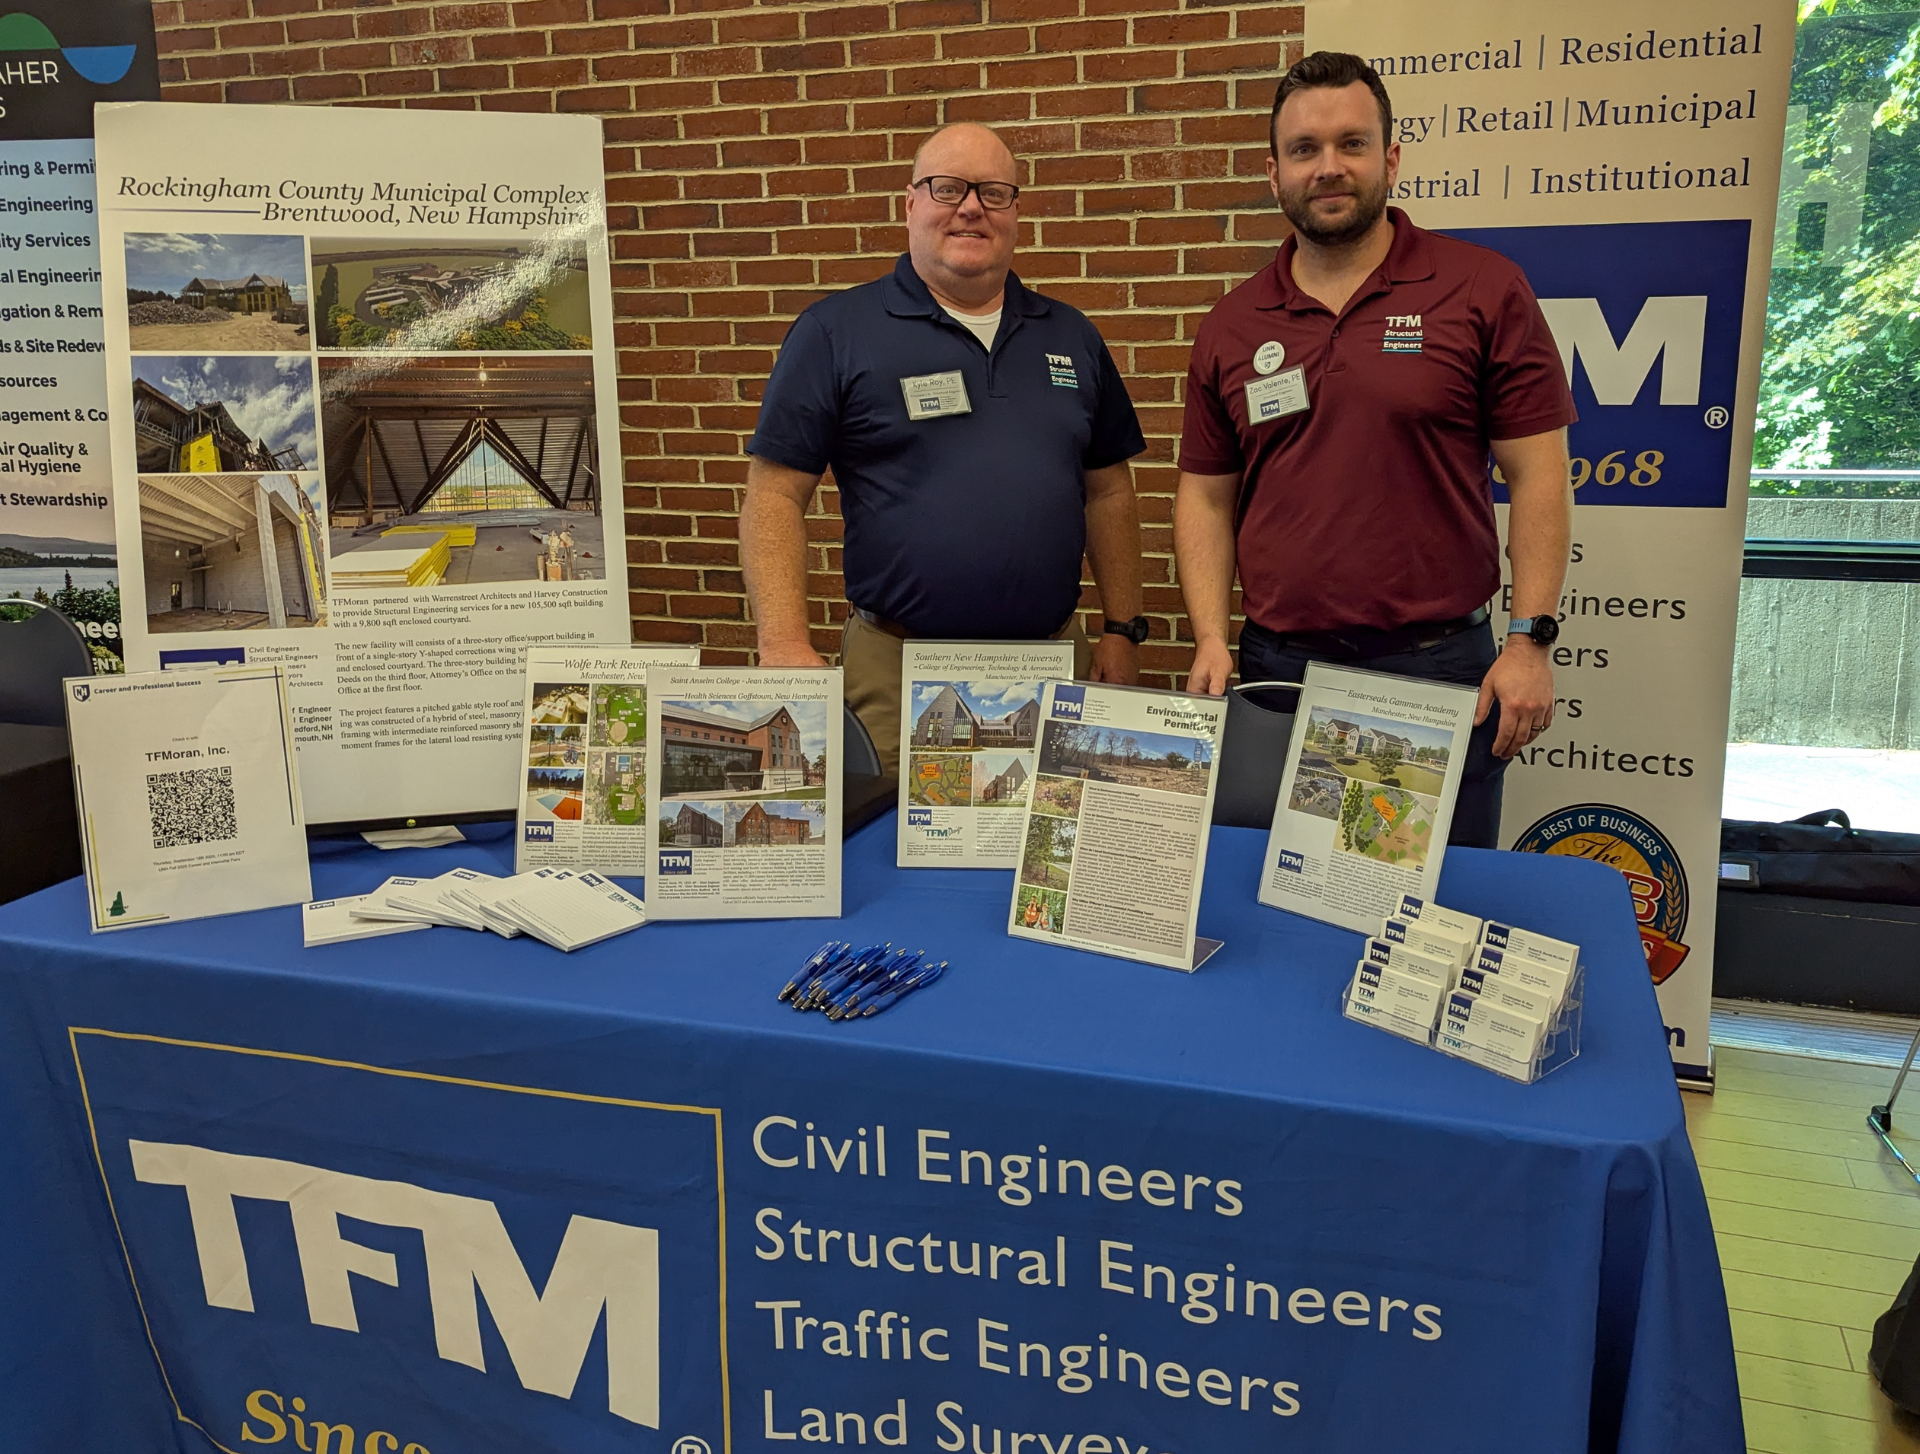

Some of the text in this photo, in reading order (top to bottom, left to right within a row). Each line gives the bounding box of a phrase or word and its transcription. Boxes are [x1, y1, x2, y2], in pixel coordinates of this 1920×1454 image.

[1559, 24, 1762, 66] Residential
[1455, 101, 1554, 134] Retail
[1575, 90, 1757, 128] Municipal
[34, 161, 45, 175] &
[47, 158, 96, 175] Permi
[1530, 158, 1751, 195] Institutional
[117, 176, 589, 208] Rockingham County Municipal Complex
[262, 202, 589, 229] Brentwood, New Hampshire
[0, 232, 91, 251] ity Services
[0, 304, 51, 321] gation
[55, 304, 65, 318] &
[1386, 315, 1422, 327] TFM
[1385, 329, 1423, 337] Structural
[14, 340, 24, 353] &
[26, 339, 54, 353] Site
[1045, 353, 1073, 367] TFM
[1049, 366, 1076, 374] Structural
[1051, 376, 1078, 385] Engineers
[1249, 373, 1301, 395] Zac Valente, PE
[921, 400, 939, 408] TFM
[1261, 403, 1278, 413] TFM
[0, 409, 71, 424] agement
[75, 409, 85, 421] &
[18, 441, 74, 458] Quality
[79, 443, 88, 455] &
[18, 459, 81, 475] Hygiene
[10, 493, 107, 509] Stewardship
[332, 598, 369, 606] TFMoran
[373, 596, 409, 606] partnered
[413, 595, 430, 603] with
[432, 594, 478, 602] Warrenstreet
[480, 592, 517, 600] Architects
[534, 590, 560, 599] Harvey
[562, 588, 608, 597] Construction
[342, 608, 372, 618] provide
[374, 607, 411, 616] Structural
[413, 605, 458, 615] Engineering
[460, 604, 489, 612] services
[528, 601, 557, 609] 105,500
[559, 600, 573, 609] sqft
[574, 599, 604, 608] building
[359, 619, 381, 628] 9,800
[382, 619, 398, 628] sqft
[399, 616, 432, 625] enclosed
[433, 615, 472, 625] courtyard.
[335, 642, 350, 650] The
[370, 641, 397, 650] facility
[398, 640, 414, 648] will
[415, 638, 446, 647] consists
[447, 637, 456, 645] of
[463, 634, 502, 645] three-story
[504, 632, 554, 643] office/support
[556, 632, 586, 641] building
[587, 631, 595, 639] in
[266, 646, 300, 654] Engineers
[249, 655, 284, 663] Structural
[564, 659, 592, 671] Wolfe
[593, 659, 618, 669] Park
[914, 652, 1064, 664] Southern New Hampshire University
[950, 664, 986, 672] Engineering,
[987, 664, 1020, 672] Technology
[580, 672, 645, 681] Manchester, New
[670, 677, 689, 685] Saint
[690, 677, 715, 685] Anselm
[716, 677, 741, 686] College
[745, 677, 762, 685] Jean
[763, 677, 785, 685] School
[785, 677, 795, 686] of
[795, 678, 822, 686] Nursing
[94, 685, 117, 694] Career
[133, 682, 175, 691] Professional
[176, 679, 202, 688] Success
[684, 692, 829, 701] Health Sciences Goffstown, New Hampshire
[1055, 700, 1082, 714] TFM
[1347, 690, 1460, 718] Easterseals Gammon Academy
[1146, 706, 1219, 723] Environmental
[1371, 706, 1457, 728] Manchester, New Hampshire
[145, 746, 230, 762] TFMoran, Inc.
[909, 813, 930, 822] TFM
[527, 826, 552, 836] TFM
[924, 829, 948, 837] TFM
[1541, 814, 1662, 857] BEST OF BUSINESS
[1564, 835, 1623, 865] The
[660, 856, 691, 868] TFM
[1281, 854, 1302, 868] TFM
[1402, 902, 1421, 916] TFM
[1386, 928, 1405, 940] TFM
[1488, 932, 1508, 946] TFM
[1371, 948, 1389, 961] TFM
[1480, 957, 1500, 971] TFM
[1362, 971, 1380, 984] TFM
[1462, 976, 1482, 990] TFM
[1450, 1002, 1471, 1017] TFM
[752, 1115, 1244, 1217] Civil Engineers
[754, 1207, 1443, 1342] Structural Engineers
[129, 1138, 659, 1430] TFM
[755, 1300, 1302, 1417] Traffic Engineers
[764, 1389, 908, 1446] Land
